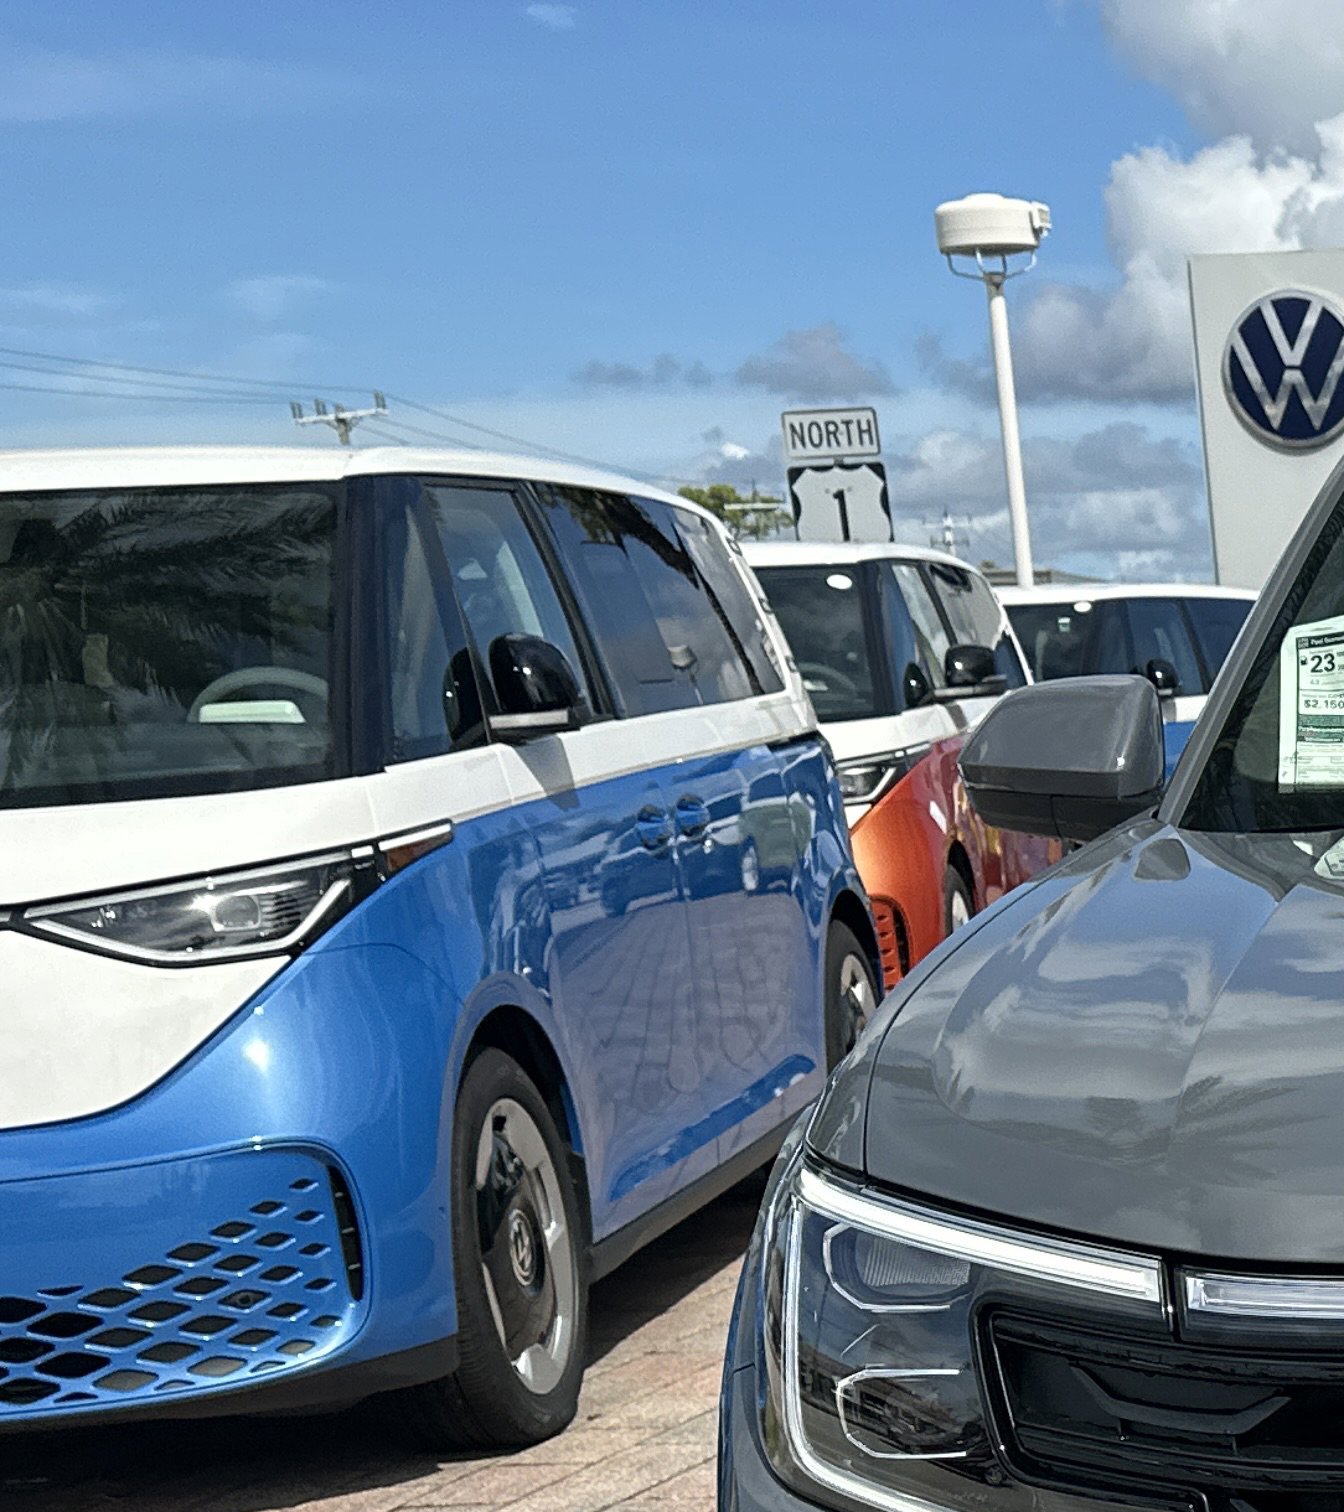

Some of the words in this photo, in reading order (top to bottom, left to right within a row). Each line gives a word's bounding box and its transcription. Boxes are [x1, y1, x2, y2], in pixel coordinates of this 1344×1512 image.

[789, 418, 875, 450] NORTH
[832, 489, 851, 542] 1
[1310, 652, 1336, 673] 23
